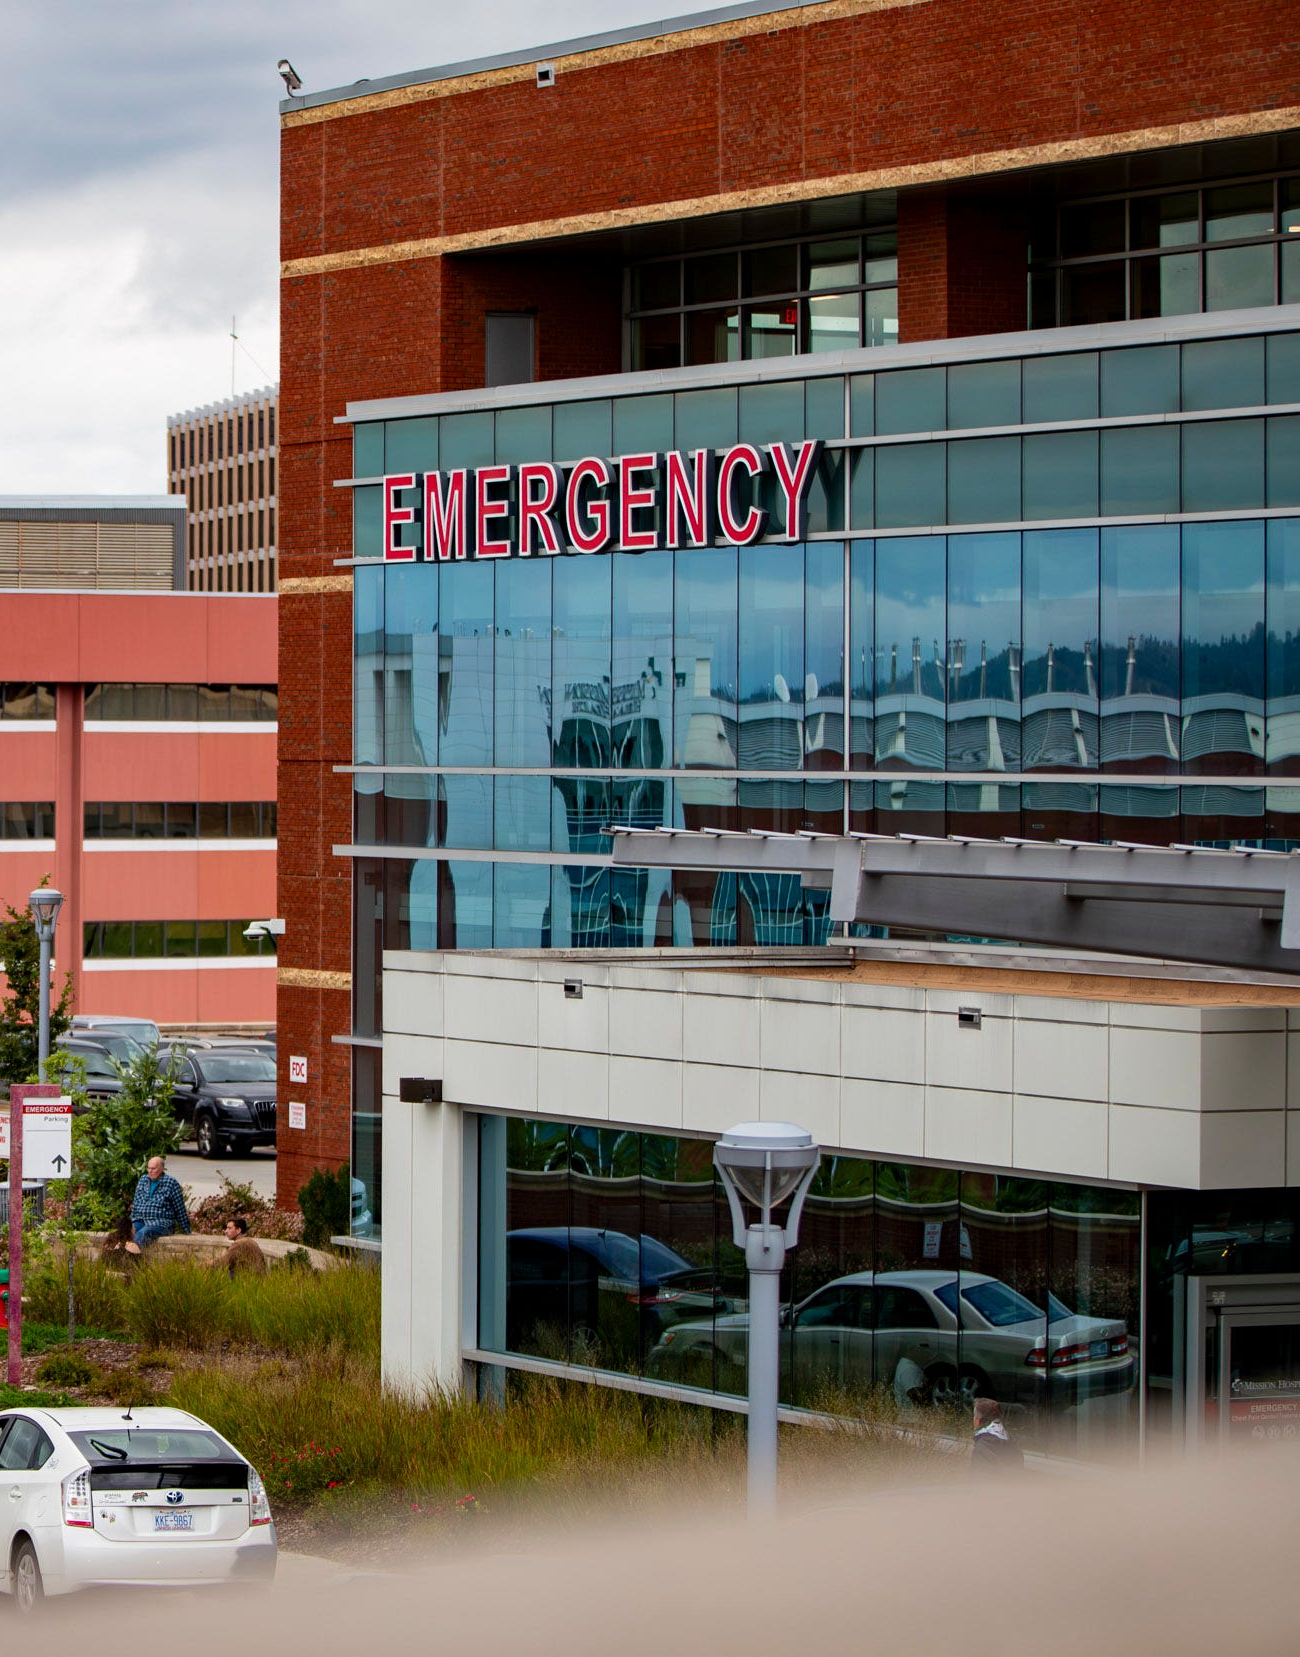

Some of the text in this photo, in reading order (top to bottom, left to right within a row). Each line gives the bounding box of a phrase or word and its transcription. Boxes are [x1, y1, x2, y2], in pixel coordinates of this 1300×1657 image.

[383, 439, 819, 563] EMERGENCY
[291, 1062, 305, 1077] FDC
[1250, 1404, 1298, 1413] EMERGENCY
